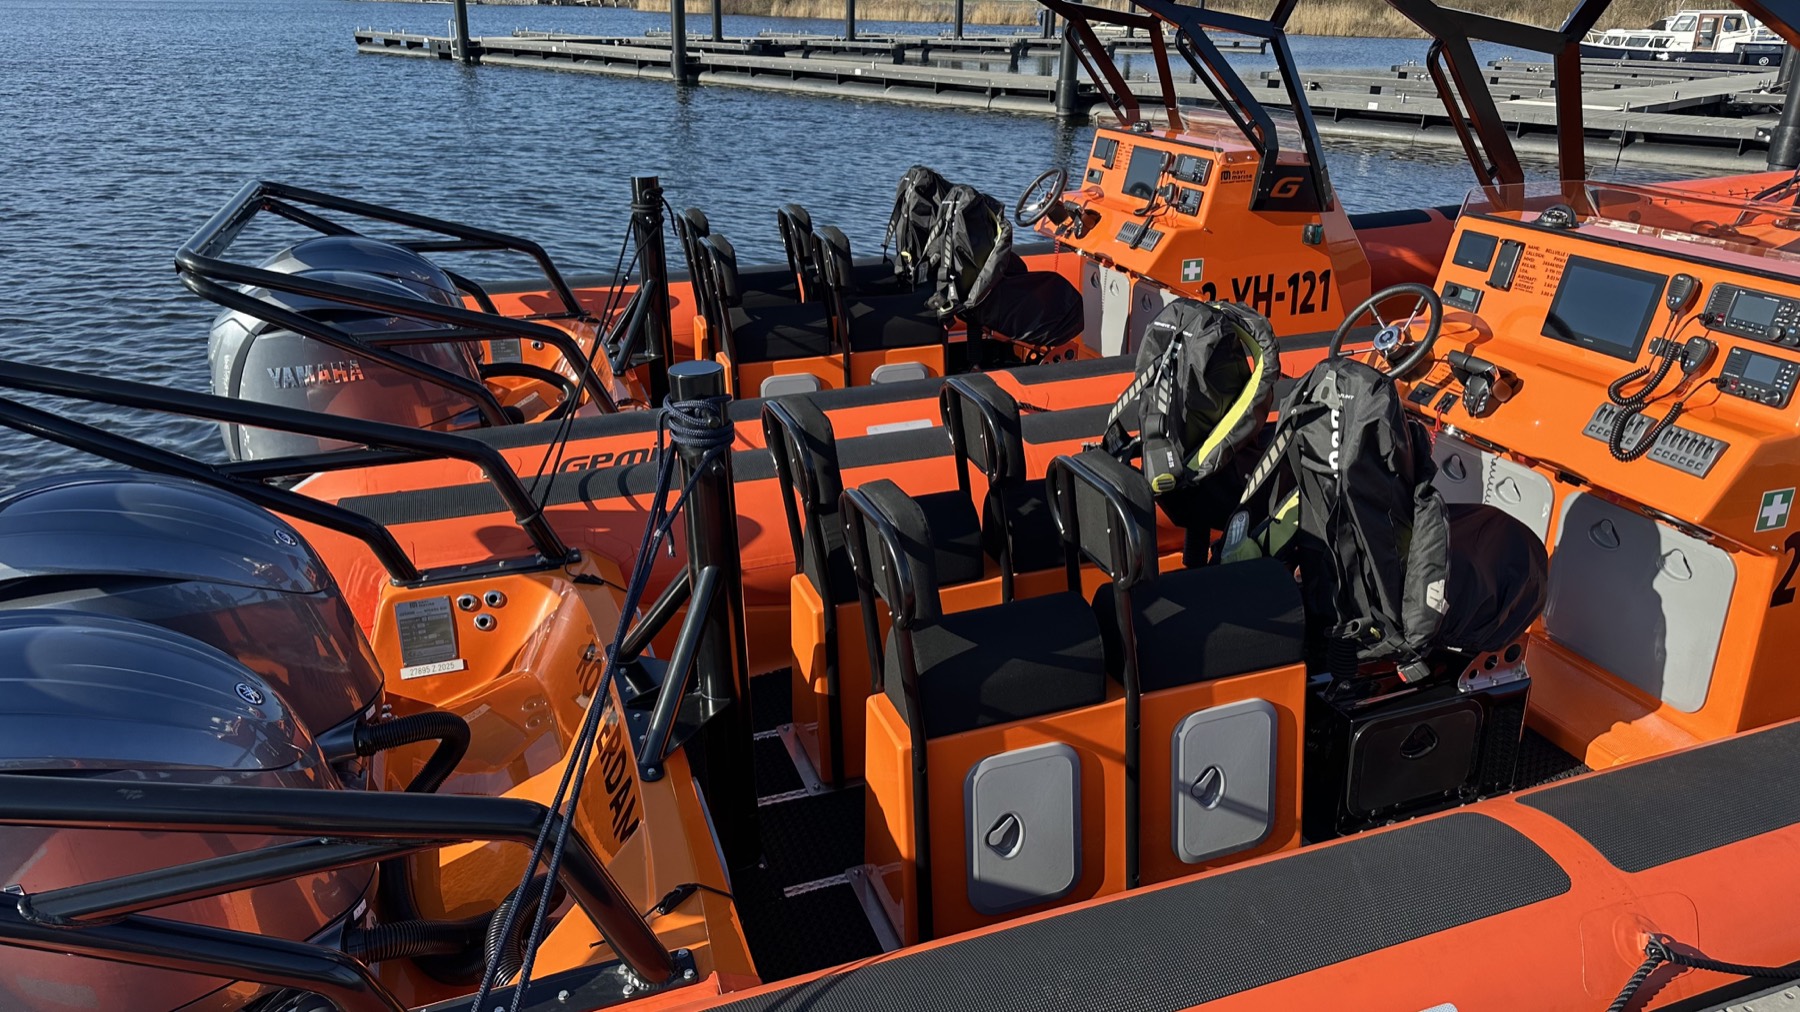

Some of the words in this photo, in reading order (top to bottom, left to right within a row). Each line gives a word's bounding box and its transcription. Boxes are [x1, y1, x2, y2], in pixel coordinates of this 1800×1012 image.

[1269, 177, 1304, 198] G
[267, 360, 365, 389] YAMAHA
[438, 662, 455, 671] 2025
[575, 639, 641, 845] ROERDAM
